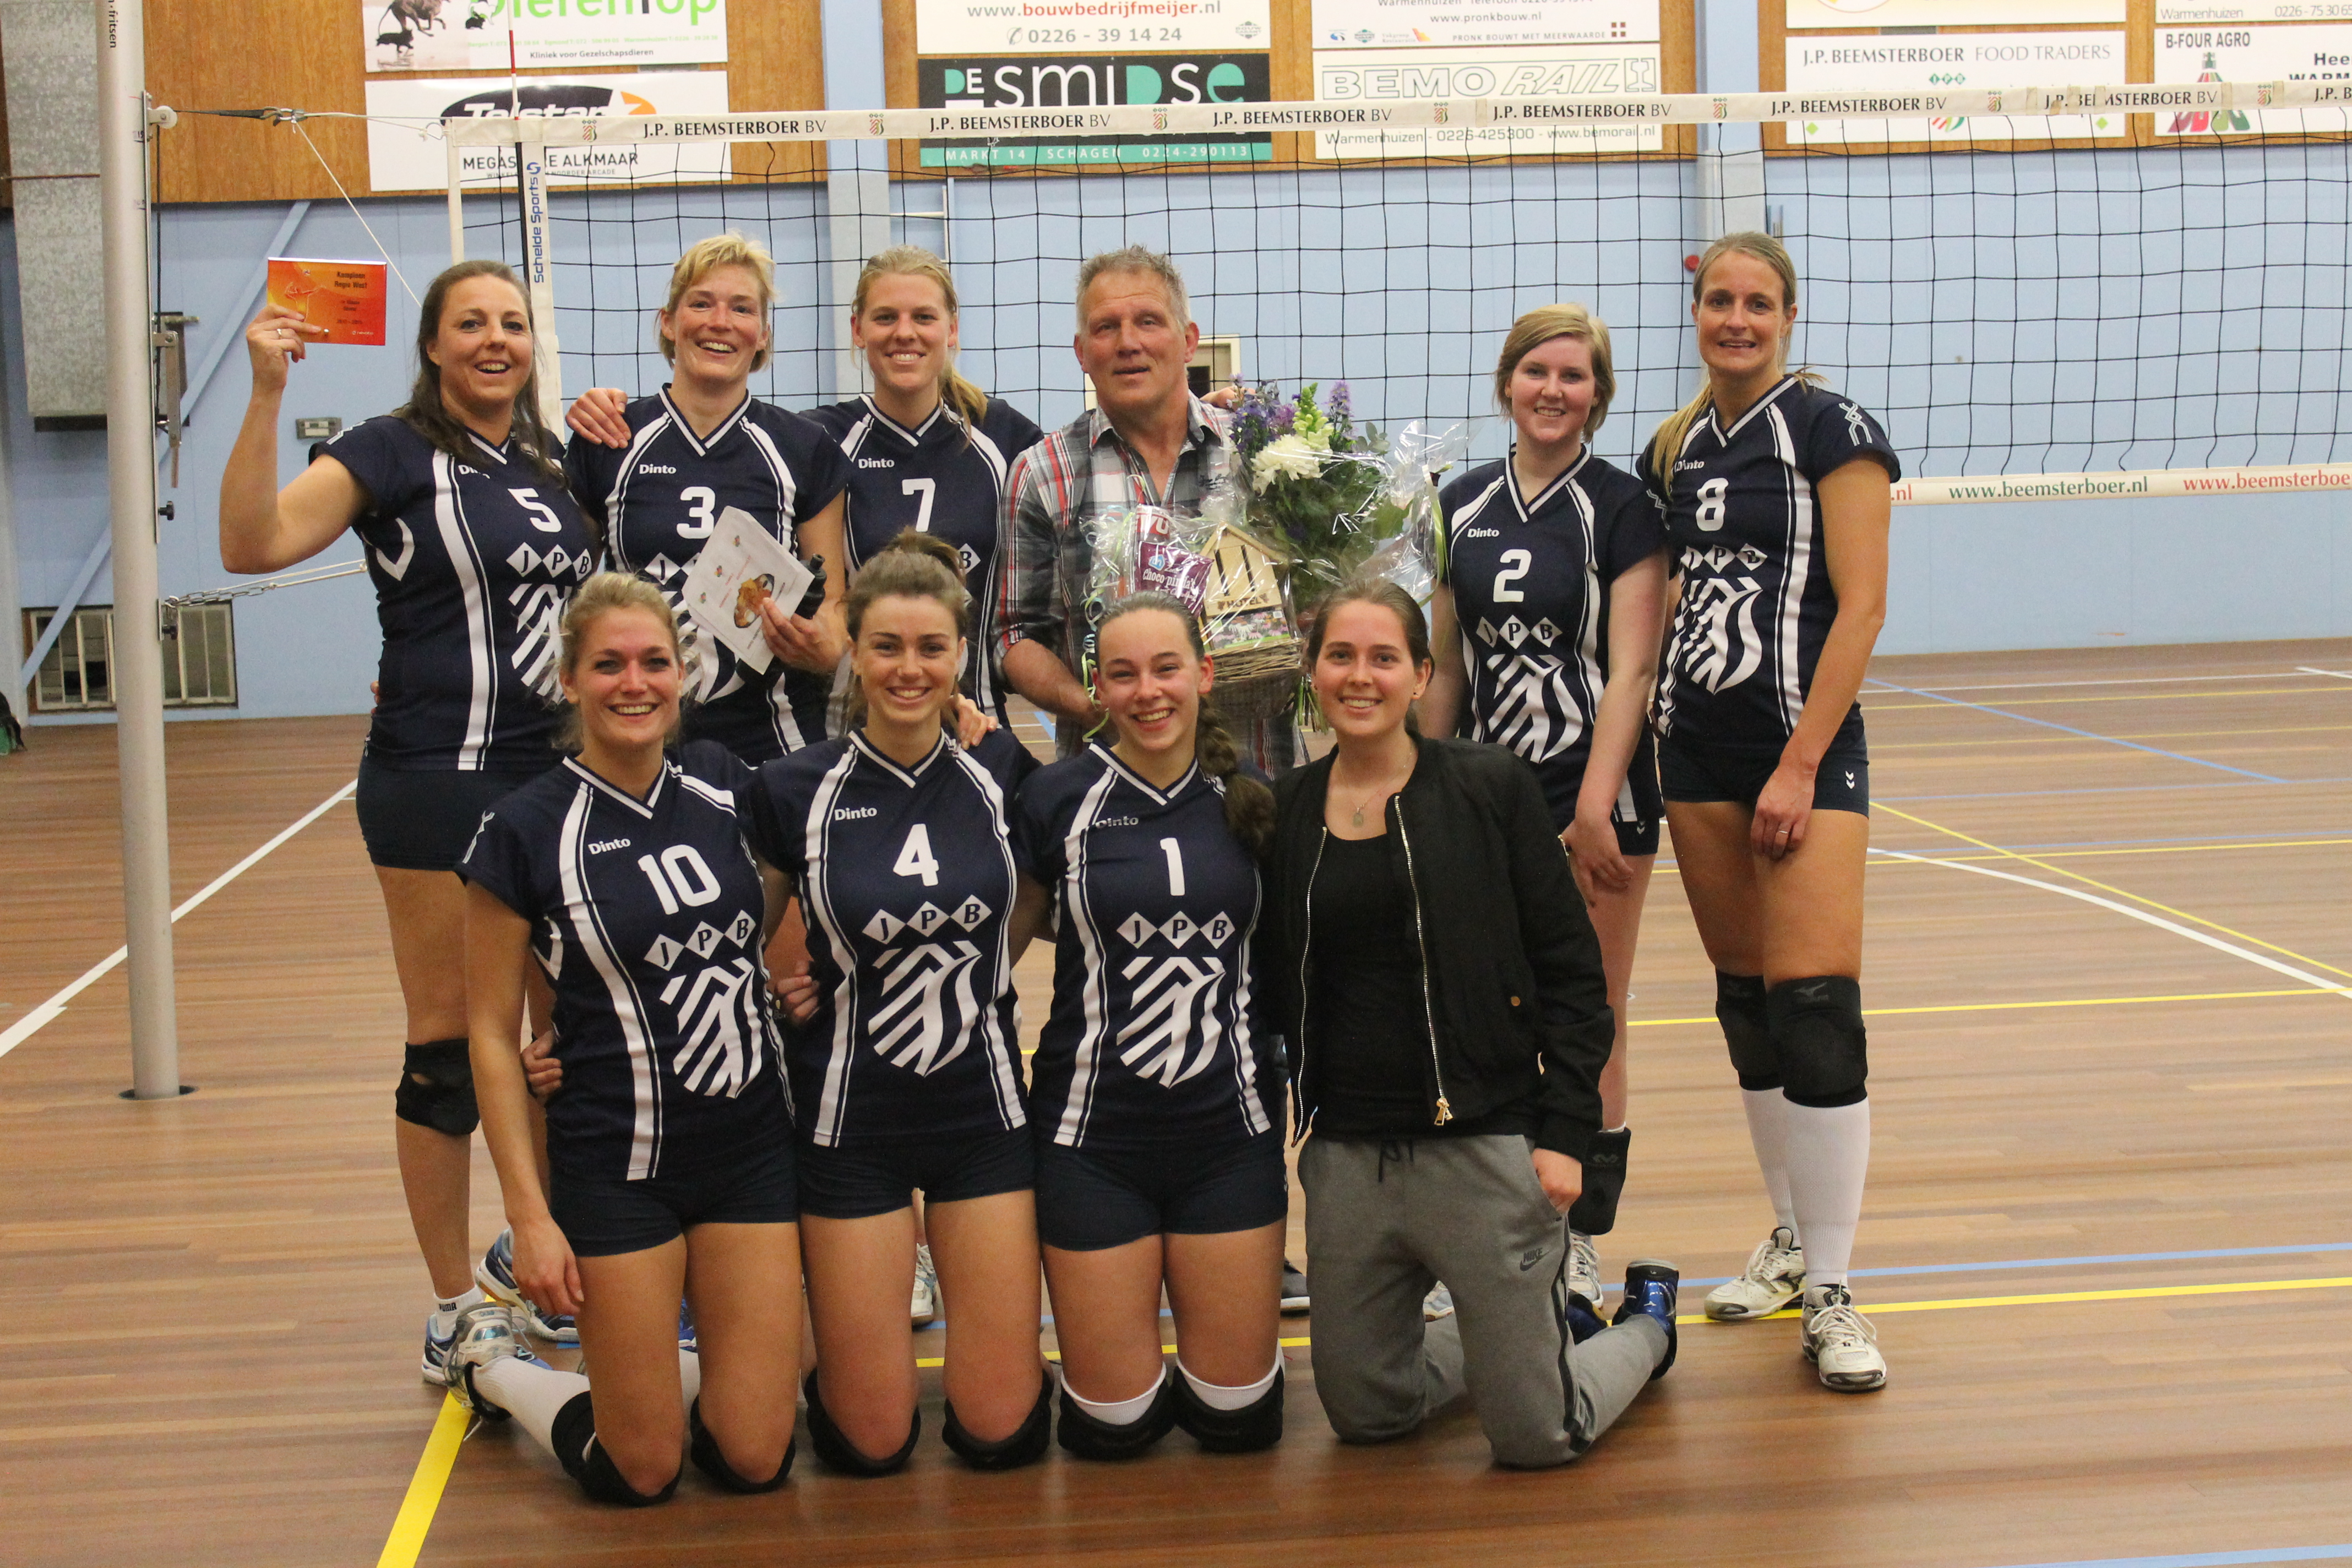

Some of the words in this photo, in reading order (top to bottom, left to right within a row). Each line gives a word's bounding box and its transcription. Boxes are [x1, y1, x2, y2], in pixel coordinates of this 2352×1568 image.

[967, 1, 1221, 18] www.bouwbedrijfmeijer.nl
[1430, 11, 1542, 24] www.pronkbouw.nl
[2160, 8, 2243, 20] Warmenhuizen
[2274, 6, 2302, 18] 0226
[2311, 6, 2323, 17] 75
[2326, 5, 2339, 16] 30
[108, 9, 118, 48] fritsen
[1028, 29, 1077, 43] 0226
[1098, 28, 1120, 42] 39
[1130, 28, 1152, 42] 14
[1159, 27, 1183, 41] 24
[1487, 33, 1518, 41] BOUWT
[1544, 31, 1606, 40] MEERWAARDE
[2166, 33, 2212, 48] B-FOUR
[2217, 32, 2251, 47] AGRO
[530, 51, 557, 59] Kliniek
[579, 49, 654, 58] Gezelschapsdieren
[1803, 50, 1828, 66] J.P.
[1832, 47, 1964, 63] BEEMSTERBOER
[1975, 46, 2029, 61] FOOD
[2035, 45, 2111, 60] TRADERS
[2314, 53, 2352, 66] Hee
[1322, 66, 1496, 100] BEMO
[1501, 64, 1619, 96] RAIL
[2197, 90, 2218, 104] BV
[2314, 87, 2338, 102] J.P.
[1493, 105, 1517, 120] J.P.
[1523, 104, 1646, 118] BEEMSTERBOER
[1651, 104, 1672, 117] BV
[1771, 100, 1795, 116] J.P.
[1800, 98, 1920, 113] BEEMSTERBOER
[1925, 96, 1947, 110] BV
[930, 116, 954, 132] J.P.
[960, 114, 1084, 130] BEEMSTERBOER
[1090, 113, 1111, 128] BV
[1213, 111, 1237, 128] J.P.
[1243, 108, 1365, 125] BEEMSTERBOER
[1371, 108, 1392, 122] BV
[644, 123, 668, 139] J.P.
[674, 120, 799, 136] BEEMSTERBOER
[805, 119, 826, 133] BV
[1325, 132, 1424, 145] Warmenhuizen
[1547, 125, 1656, 139] www.bemorail.nl
[563, 152, 638, 167] ALKMAAR
[946, 149, 998, 160] MARKT
[1009, 149, 1026, 160] 14
[1047, 148, 1121, 159] SCHAGEN
[528, 176, 543, 224] Sports
[532, 226, 544, 283] Schelde
[639, 464, 677, 475] Dinto
[858, 458, 895, 469] Dinto
[1948, 476, 2148, 499] www.beemsterboer.nl
[507, 487, 563, 533] 5
[676, 486, 716, 540] 3
[902, 477, 937, 532] 7
[1695, 477, 1729, 532] 8
[1467, 527, 1500, 538] Dinto
[1142, 568, 1166, 584] Choco
[1493, 548, 1532, 603] 2
[834, 806, 878, 821] Dinto
[587, 838, 631, 855] Dinto
[892, 823, 940, 887] 4
[1159, 837, 1186, 896] 1
[637, 843, 722, 916] 10
